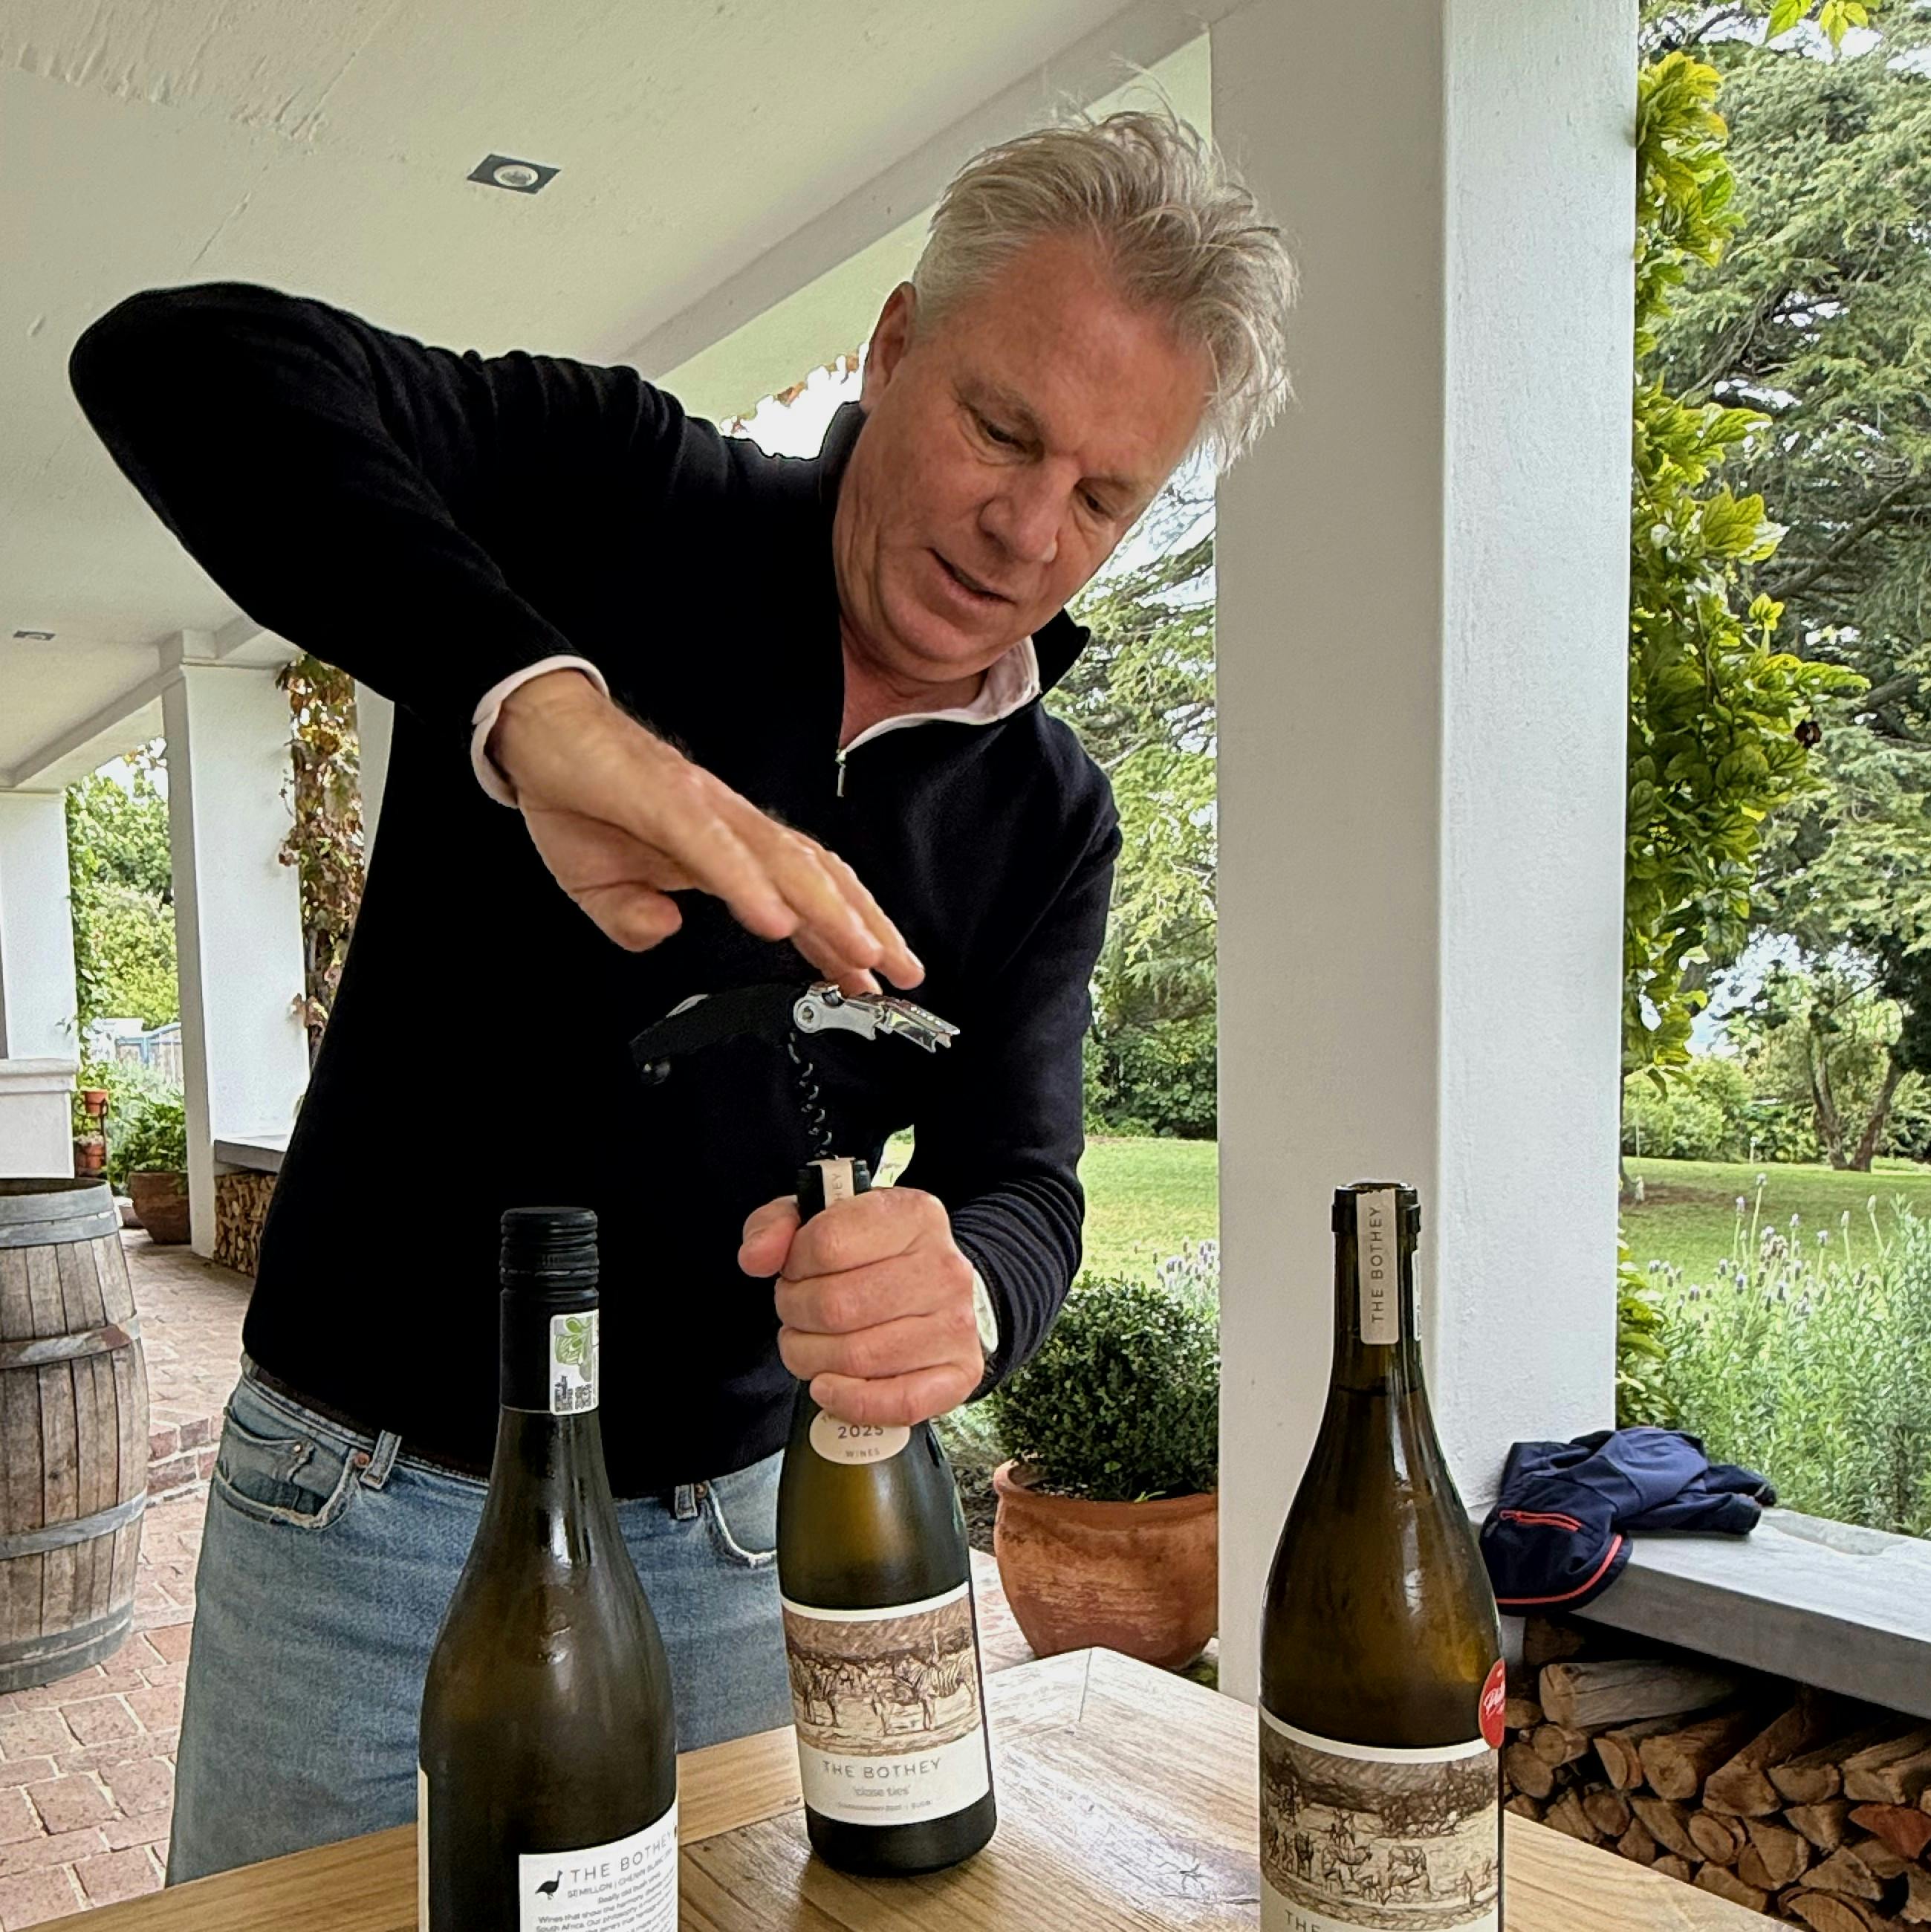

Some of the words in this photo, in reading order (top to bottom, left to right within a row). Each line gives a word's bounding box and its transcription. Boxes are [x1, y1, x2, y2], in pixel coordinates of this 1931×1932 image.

[832, 1173, 845, 1202] HEY
[1368, 1206, 1384, 1280] BOTHEY
[1371, 1288, 1384, 1324] THE
[845, 1448, 880, 1458] WINES
[822, 1760, 854, 1778] THE
[863, 1757, 941, 1779] BOTHEY
[570, 1863, 611, 1883] THE
